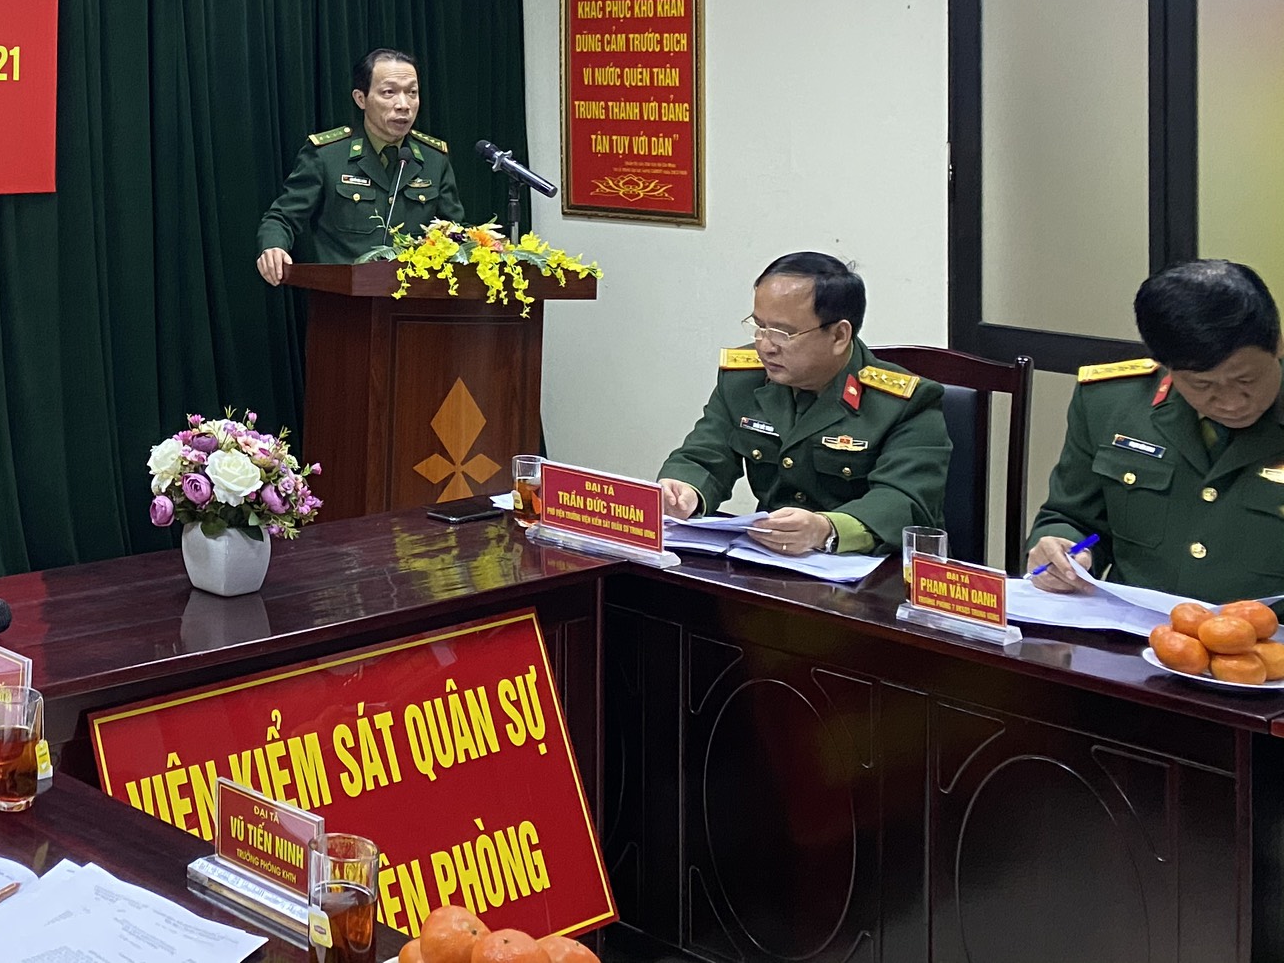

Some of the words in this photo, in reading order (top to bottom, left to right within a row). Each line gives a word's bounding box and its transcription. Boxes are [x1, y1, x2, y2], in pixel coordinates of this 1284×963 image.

[605, 0, 631, 22] PHỤC
[575, 30, 602, 52] DŨNG
[604, 26, 626, 52] CẢM
[628, 28, 661, 52] TRƯỚC
[663, 32, 687, 56] ĐỊCH
[583, 63, 593, 85] VÌ
[595, 61, 621, 86] NƯỚC
[623, 63, 650, 88] QUÊN
[653, 63, 680, 87] THÂN
[574, 100, 606, 119] TRUNG
[608, 97, 640, 121] THÀNH
[642, 96, 659, 121] VỚI
[661, 94, 690, 122] ĐẢNG
[591, 130, 610, 157] TẬN
[612, 135, 630, 158] TỤY
[632, 130, 648, 155] VỚI
[585, 480, 601, 494] ĐẠI
[602, 484, 615, 496] TÁ
[585, 497, 607, 514] ĐỨC
[609, 504, 644, 524] THUẬN
[920, 577, 947, 597] PHẠM
[949, 583, 969, 602] VĂN
[971, 589, 997, 608] OANH
[332, 701, 402, 798] SÁT
[404, 678, 501, 782] QUÂN
[497, 665, 548, 756] SỰ
[253, 805, 268, 819] ĐẠI
[230, 815, 245, 842] VŨ
[247, 822, 272, 855] TIẾN
[275, 835, 304, 870] NINH
[376, 852, 430, 939] ÊN
[430, 817, 551, 918] PHÒNG
